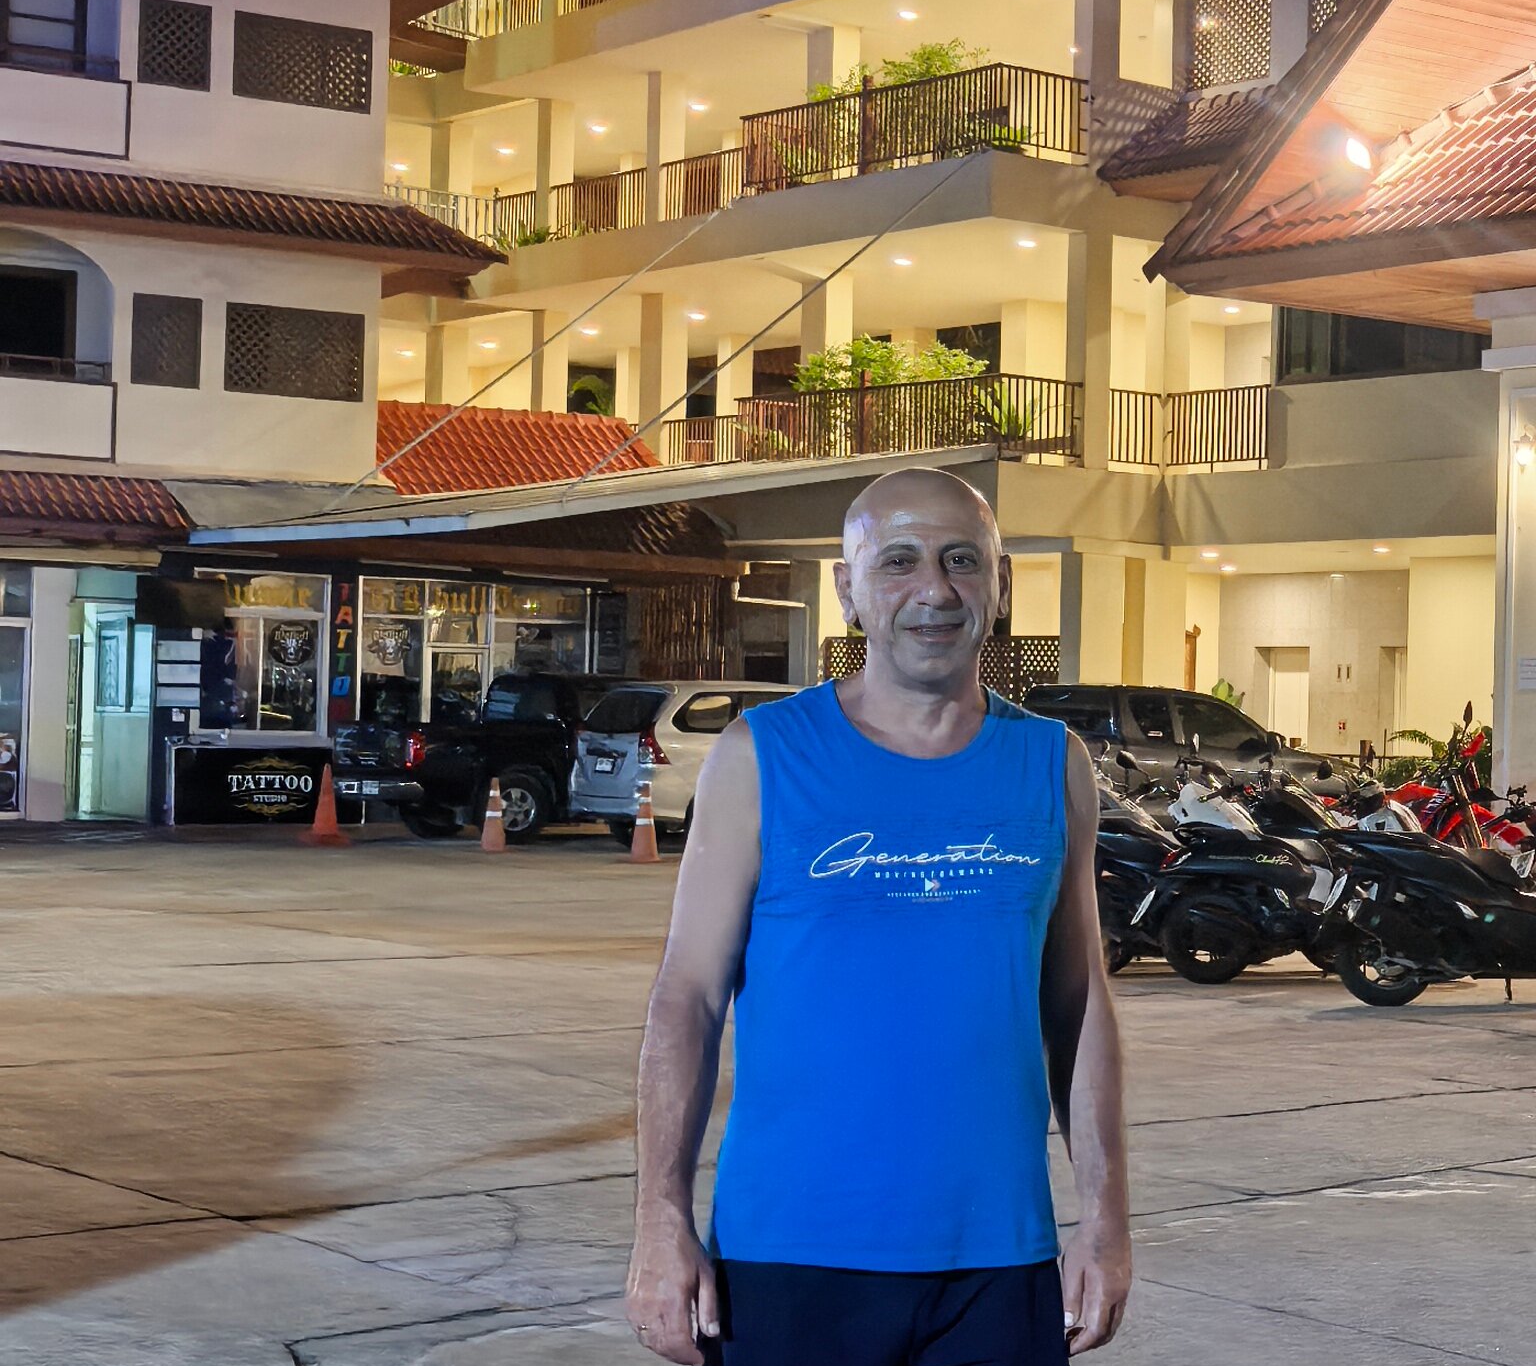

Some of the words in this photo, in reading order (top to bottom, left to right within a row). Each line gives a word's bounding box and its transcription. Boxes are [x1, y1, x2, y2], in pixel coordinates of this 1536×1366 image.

[332, 583, 353, 719] TATTO
[228, 775, 312, 792] TATTOO
[253, 795, 288, 803] STUDIO
[809, 832, 1040, 877] Generation
